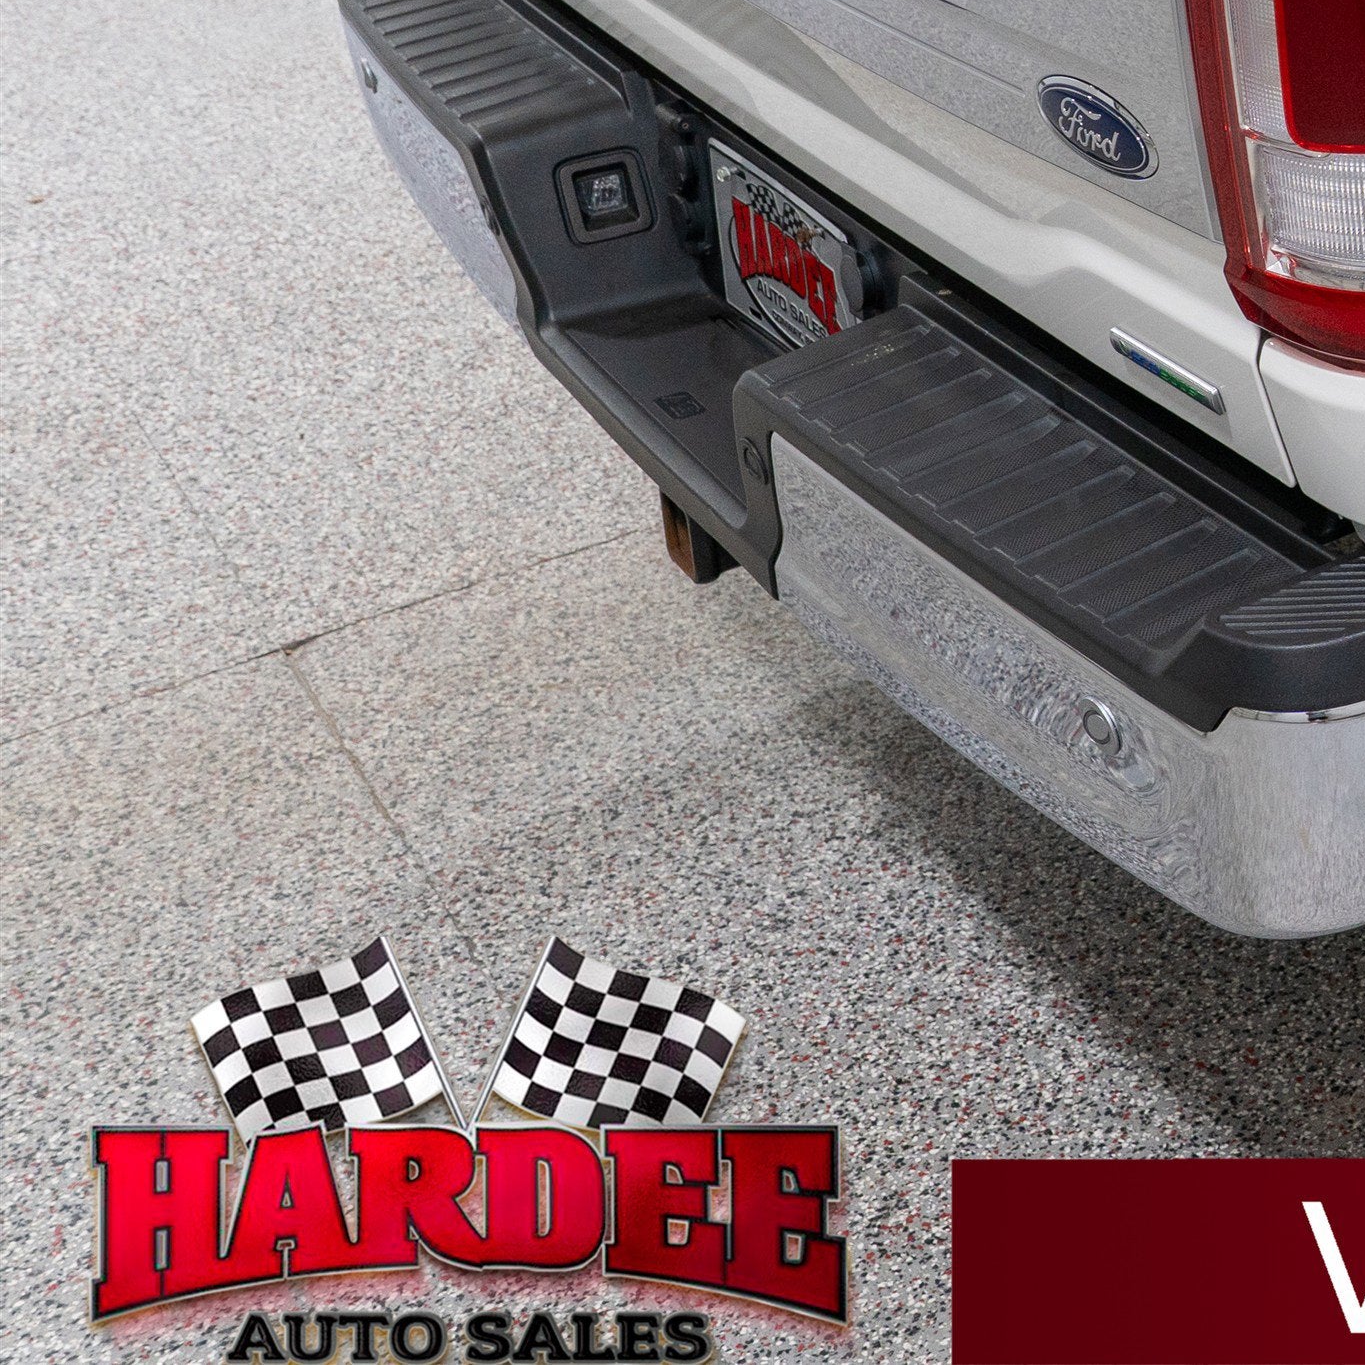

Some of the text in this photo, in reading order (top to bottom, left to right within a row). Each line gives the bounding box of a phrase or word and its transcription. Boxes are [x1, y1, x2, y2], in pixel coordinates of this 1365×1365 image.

[1058, 97, 1121, 162] Ford
[731, 195, 843, 336] HARDEE
[757, 278, 787, 313] AUTO
